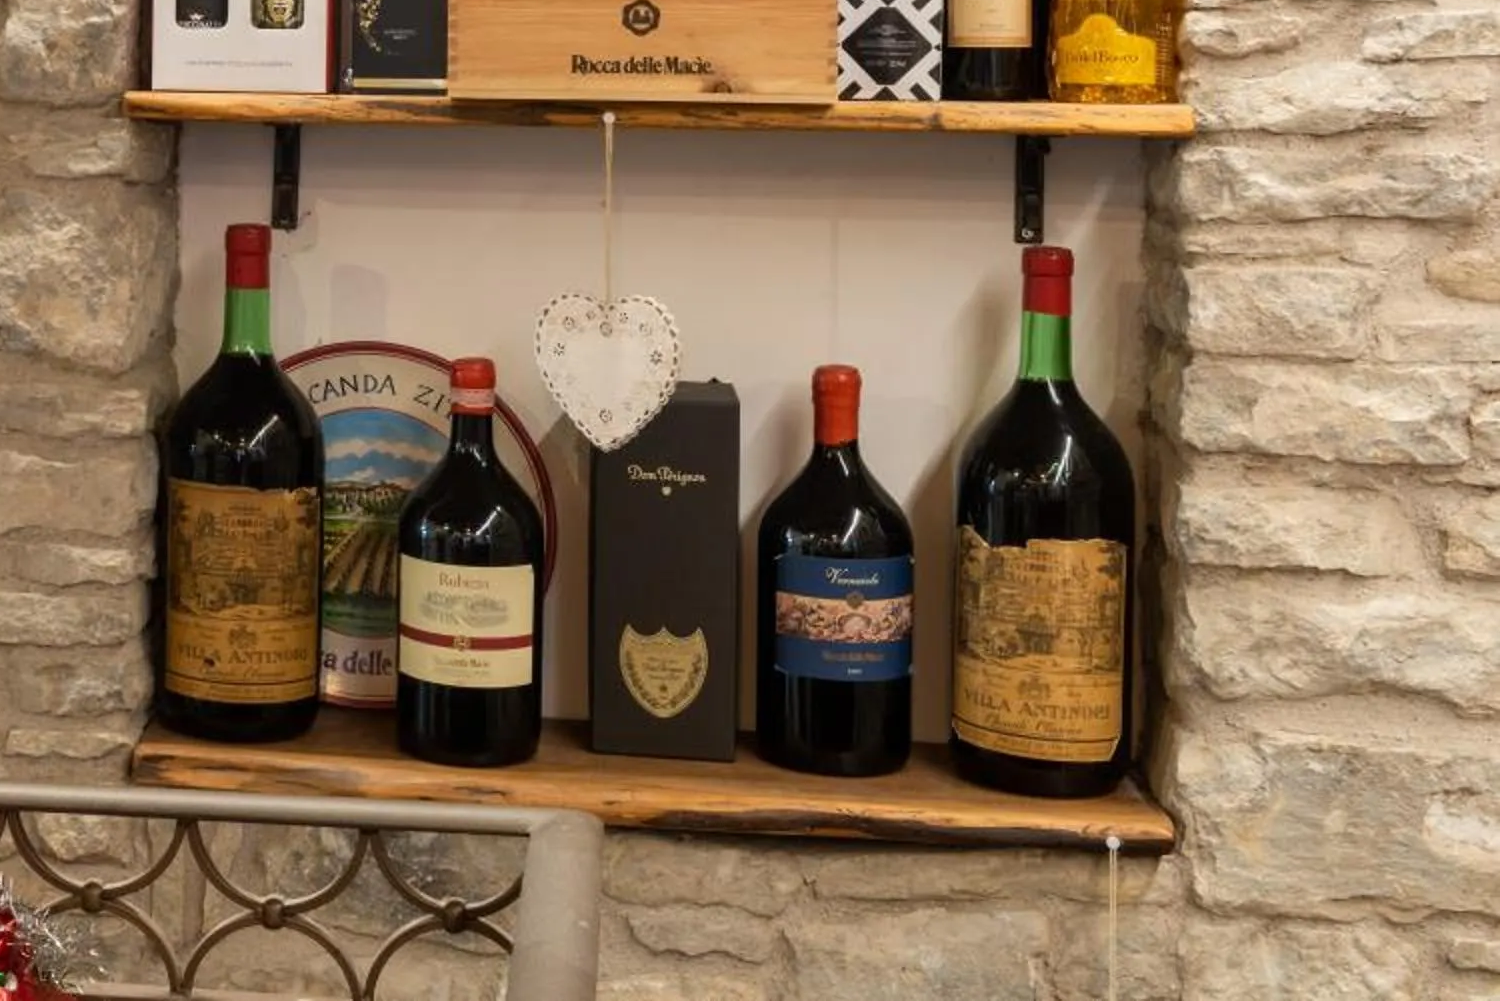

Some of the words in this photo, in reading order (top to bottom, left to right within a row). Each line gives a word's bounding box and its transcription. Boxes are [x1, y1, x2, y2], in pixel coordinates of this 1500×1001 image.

[571, 55, 620, 75] Rocca
[624, 56, 662, 74] delle
[308, 374, 398, 405] CANDA
[412, 383, 451, 420] ZI
